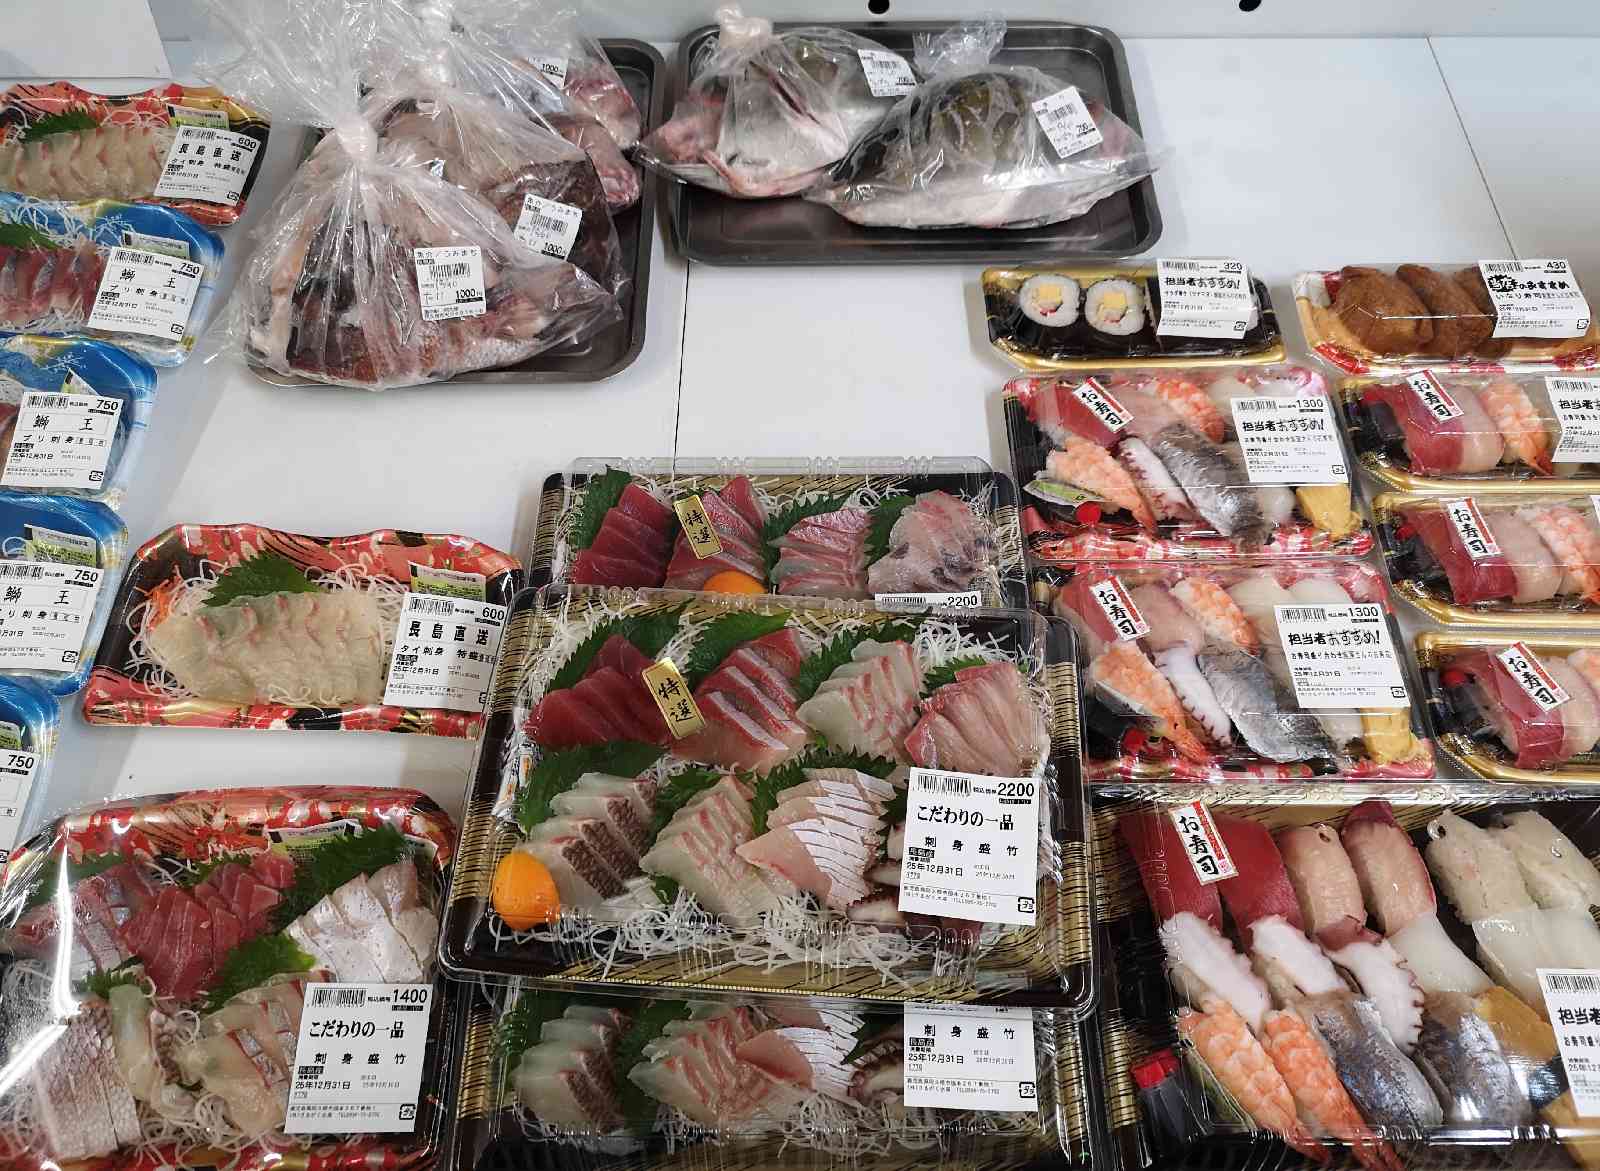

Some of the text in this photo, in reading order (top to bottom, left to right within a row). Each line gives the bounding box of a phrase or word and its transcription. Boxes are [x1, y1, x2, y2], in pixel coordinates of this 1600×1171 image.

[238, 137, 257, 149] 600
[179, 143, 241, 161] 長島直送
[545, 242, 563, 254] 1000
[180, 262, 200, 275] 750
[1224, 262, 1242, 271] 320
[456, 288, 476, 299] 1000
[96, 399, 119, 411] 750
[1296, 399, 1324, 408] 1300
[1413, 379, 1452, 417] お寿司
[1081, 390, 1123, 427] お寿司
[33, 413, 93, 430] 鰤王
[685, 509, 712, 544] 特選
[1453, 509, 1488, 554] お寿司
[74, 569, 99, 582] 750
[947, 595, 979, 607] 2200
[482, 607, 505, 620] 600
[1100, 585, 1137, 635] お寿司
[1348, 606, 1379, 617] 1300
[408, 621, 489, 645] 長島直送
[1288, 629, 1380, 646] 担当者おすすめ!
[1508, 656, 1558, 704] お寿司
[658, 677, 695, 722] 特選
[7, 754, 34, 769] 750
[998, 783, 1034, 796] 2200
[917, 806, 1013, 830] こだわりの一品
[925, 836, 1018, 856] 刺身盛竹
[1179, 815, 1219, 875] お寿司
[907, 862, 963, 876] 25年12月31日
[393, 989, 428, 1003] 1400
[309, 1018, 404, 1039] こだわりの一品
[924, 1024, 1014, 1039] 刺身盛竹
[314, 1053, 406, 1065] 刺身盛竹
[908, 1054, 964, 1064] 25年12月31日
[295, 1081, 350, 1090] 25年12月31日
